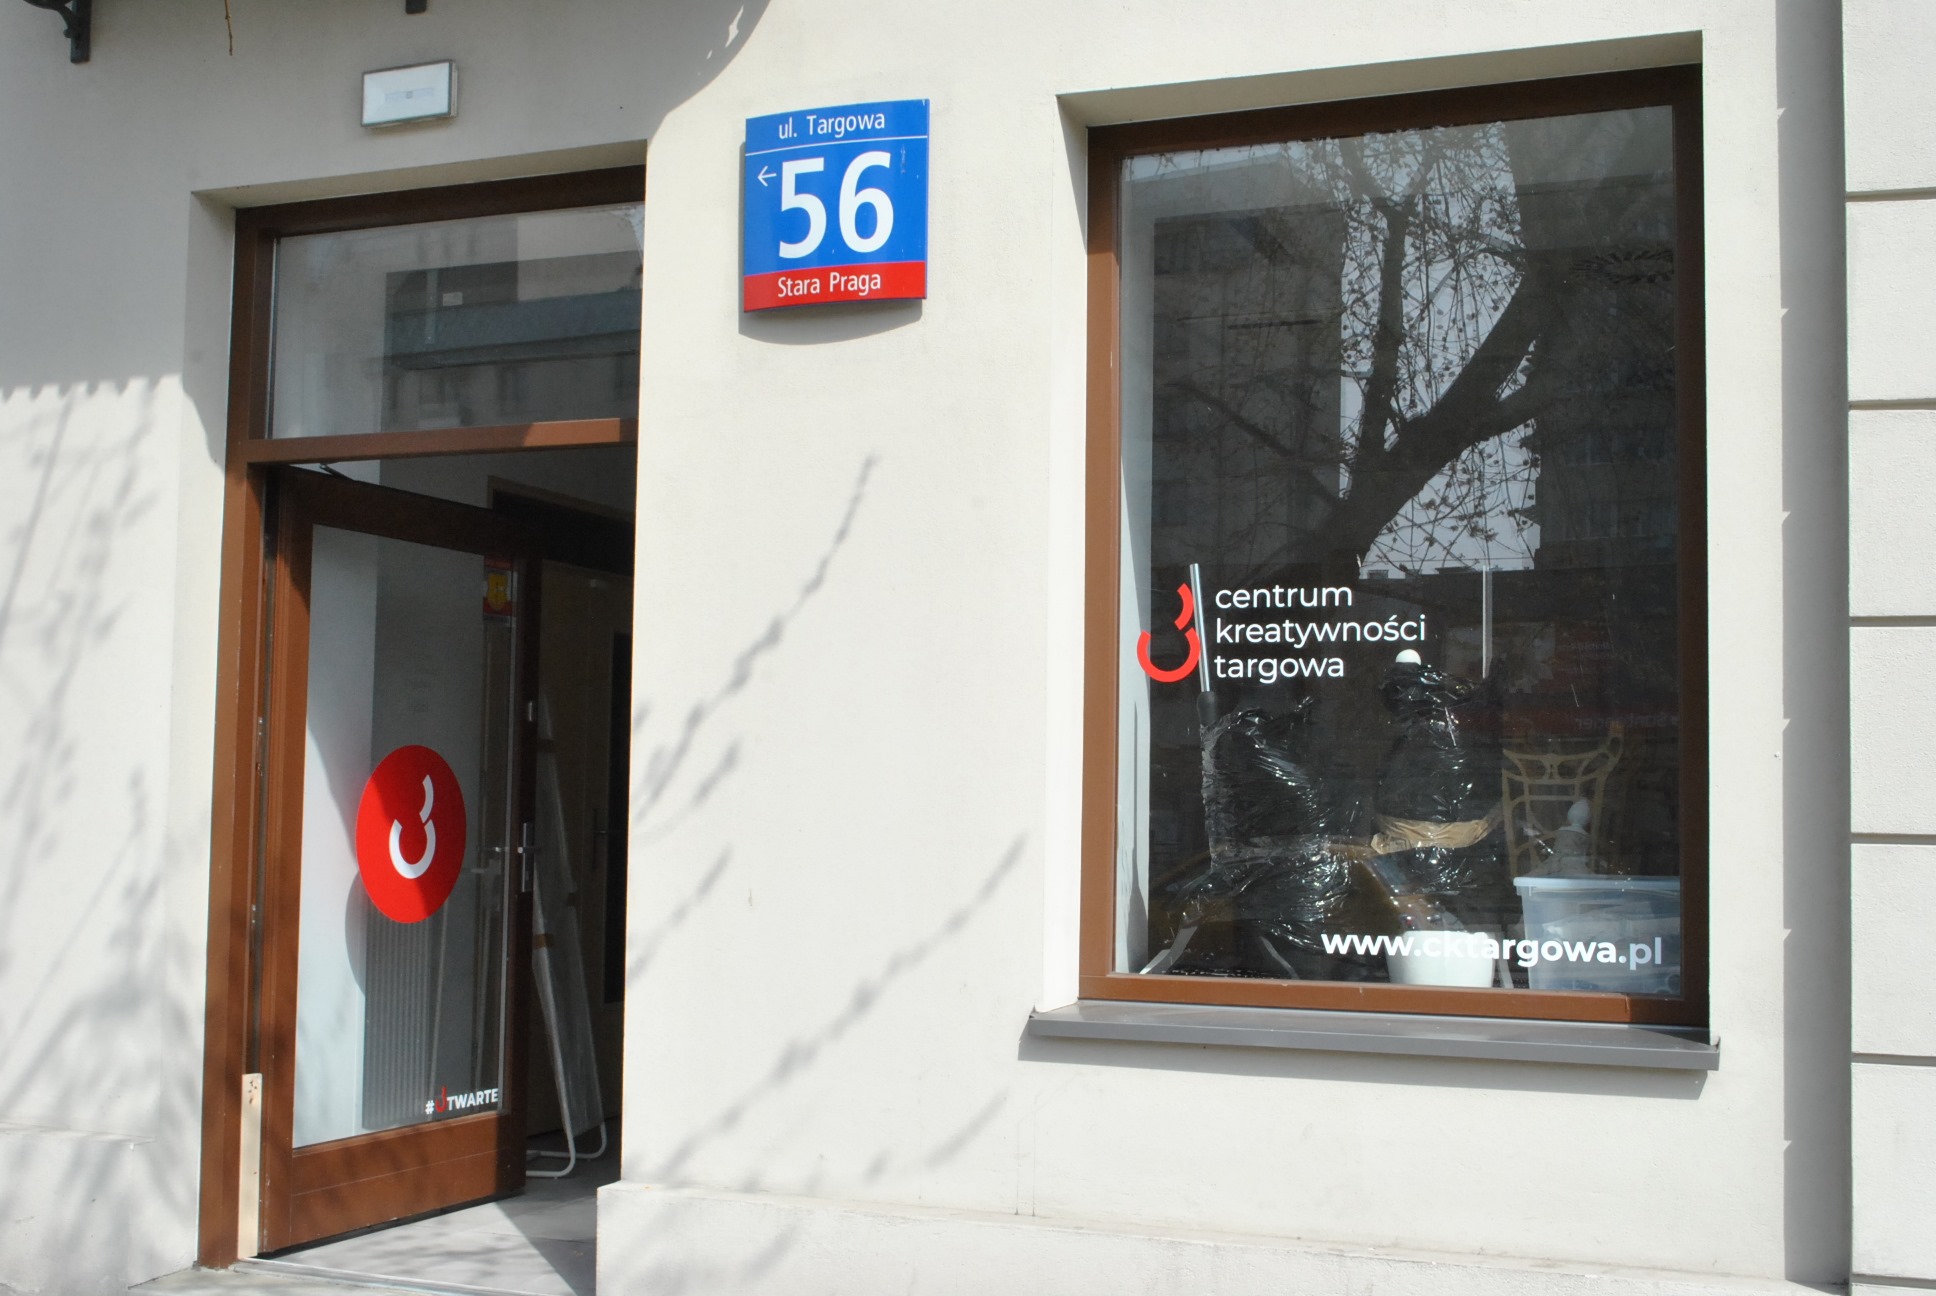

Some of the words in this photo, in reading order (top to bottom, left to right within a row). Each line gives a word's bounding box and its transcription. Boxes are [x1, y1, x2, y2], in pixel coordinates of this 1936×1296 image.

[779, 117, 797, 139] ul.
[807, 113, 885, 138] Targowa
[779, 151, 894, 259] 56
[777, 276, 820, 297] Stara
[829, 272, 881, 296] Praga
[1215, 585, 1352, 608] centrum
[1216, 614, 1426, 648] kreatywności
[1214, 655, 1345, 684] targowa
[1321, 933, 1662, 970] www.cktargowa.pl
